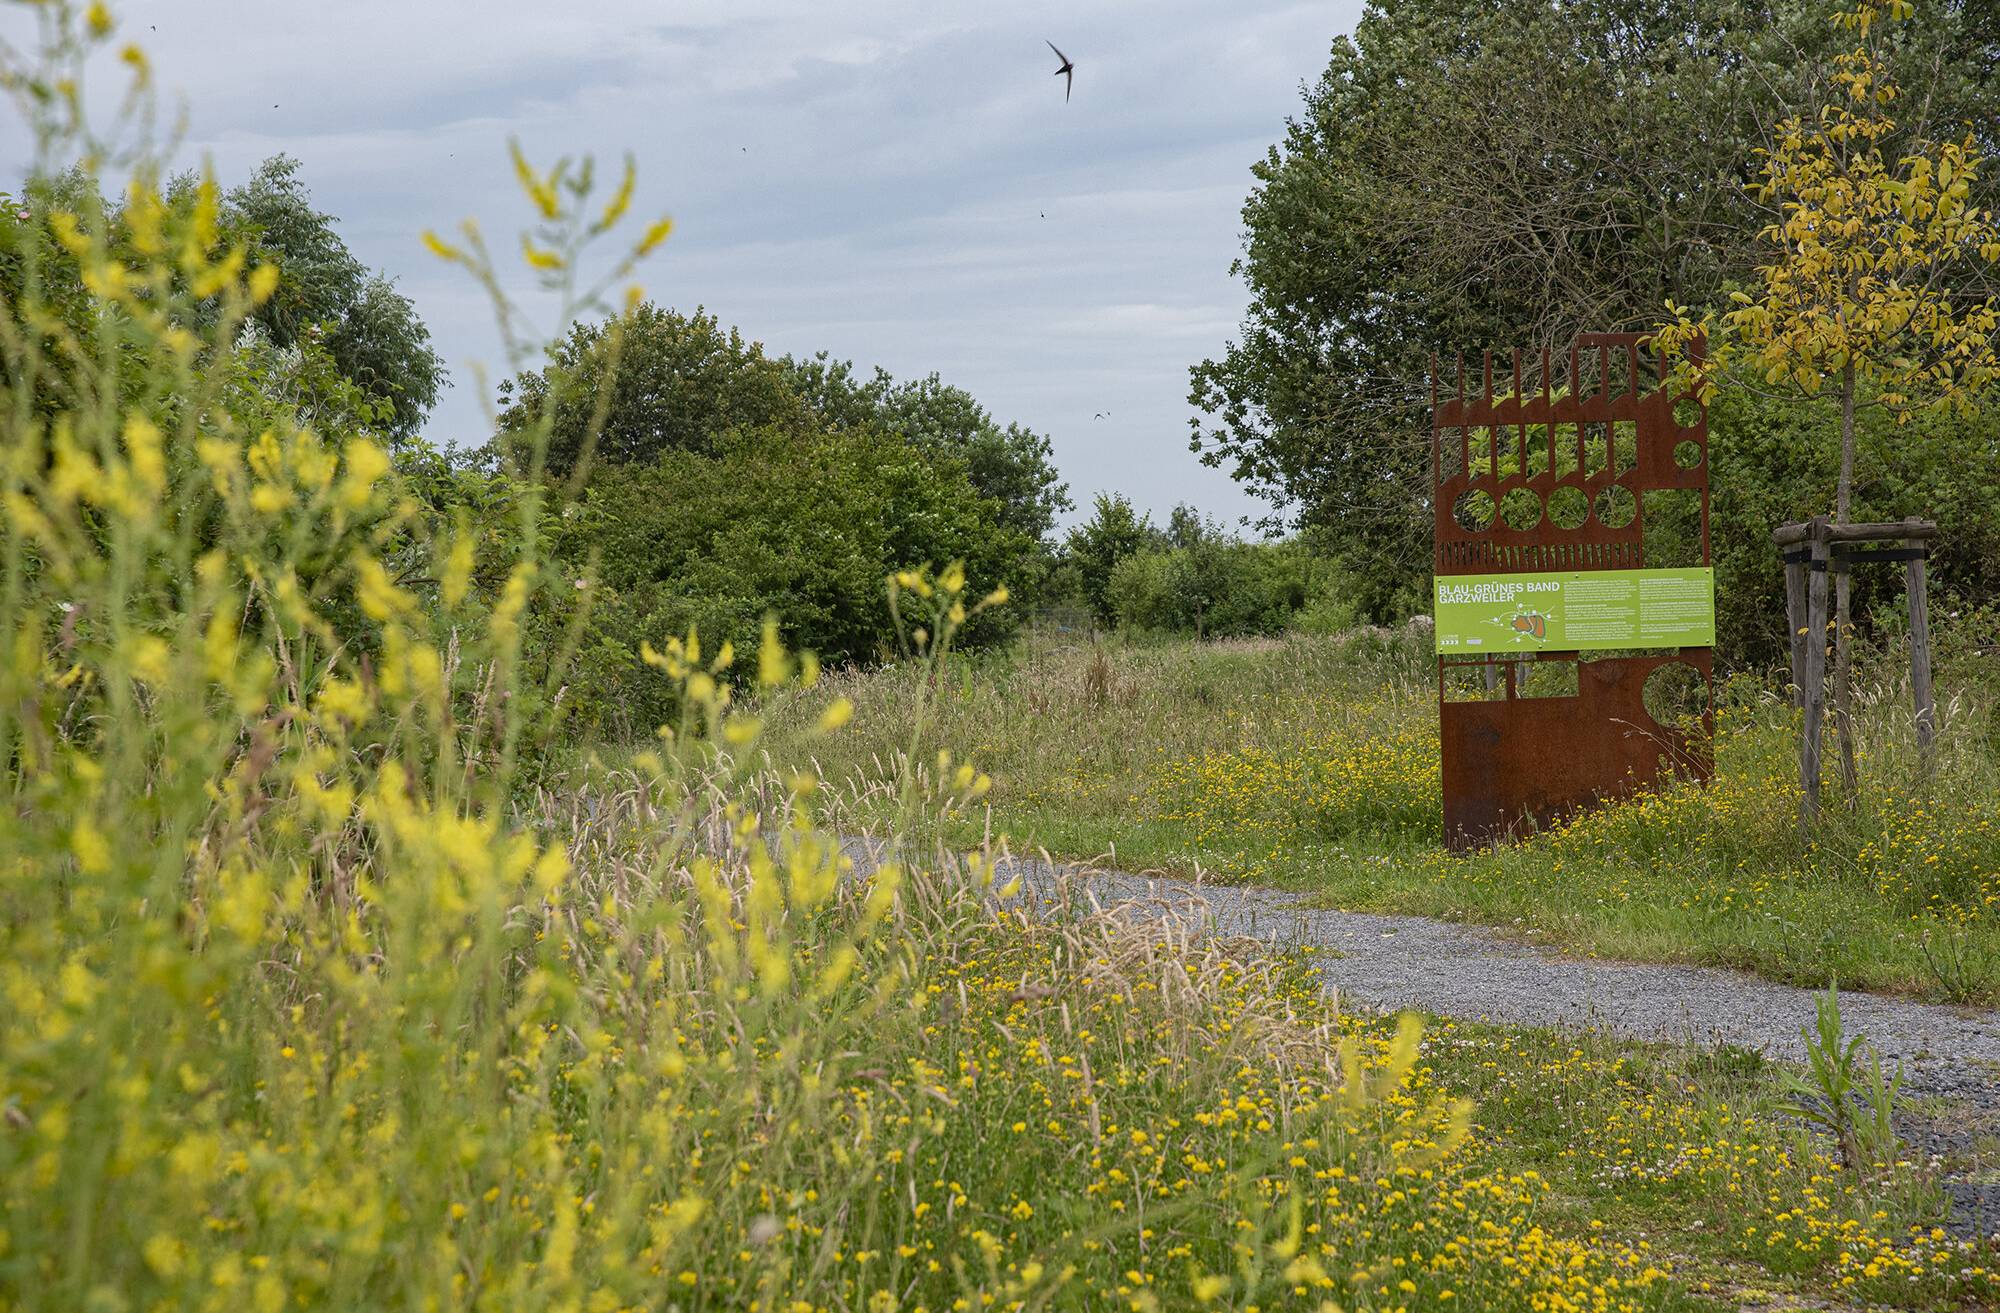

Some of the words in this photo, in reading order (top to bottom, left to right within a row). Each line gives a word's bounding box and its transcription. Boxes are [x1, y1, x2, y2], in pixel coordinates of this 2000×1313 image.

[1439, 581, 1524, 594] BLAU-GRÜNES
[1526, 582, 1560, 592] BAND
[1439, 592, 1514, 603] GARZWEILER
